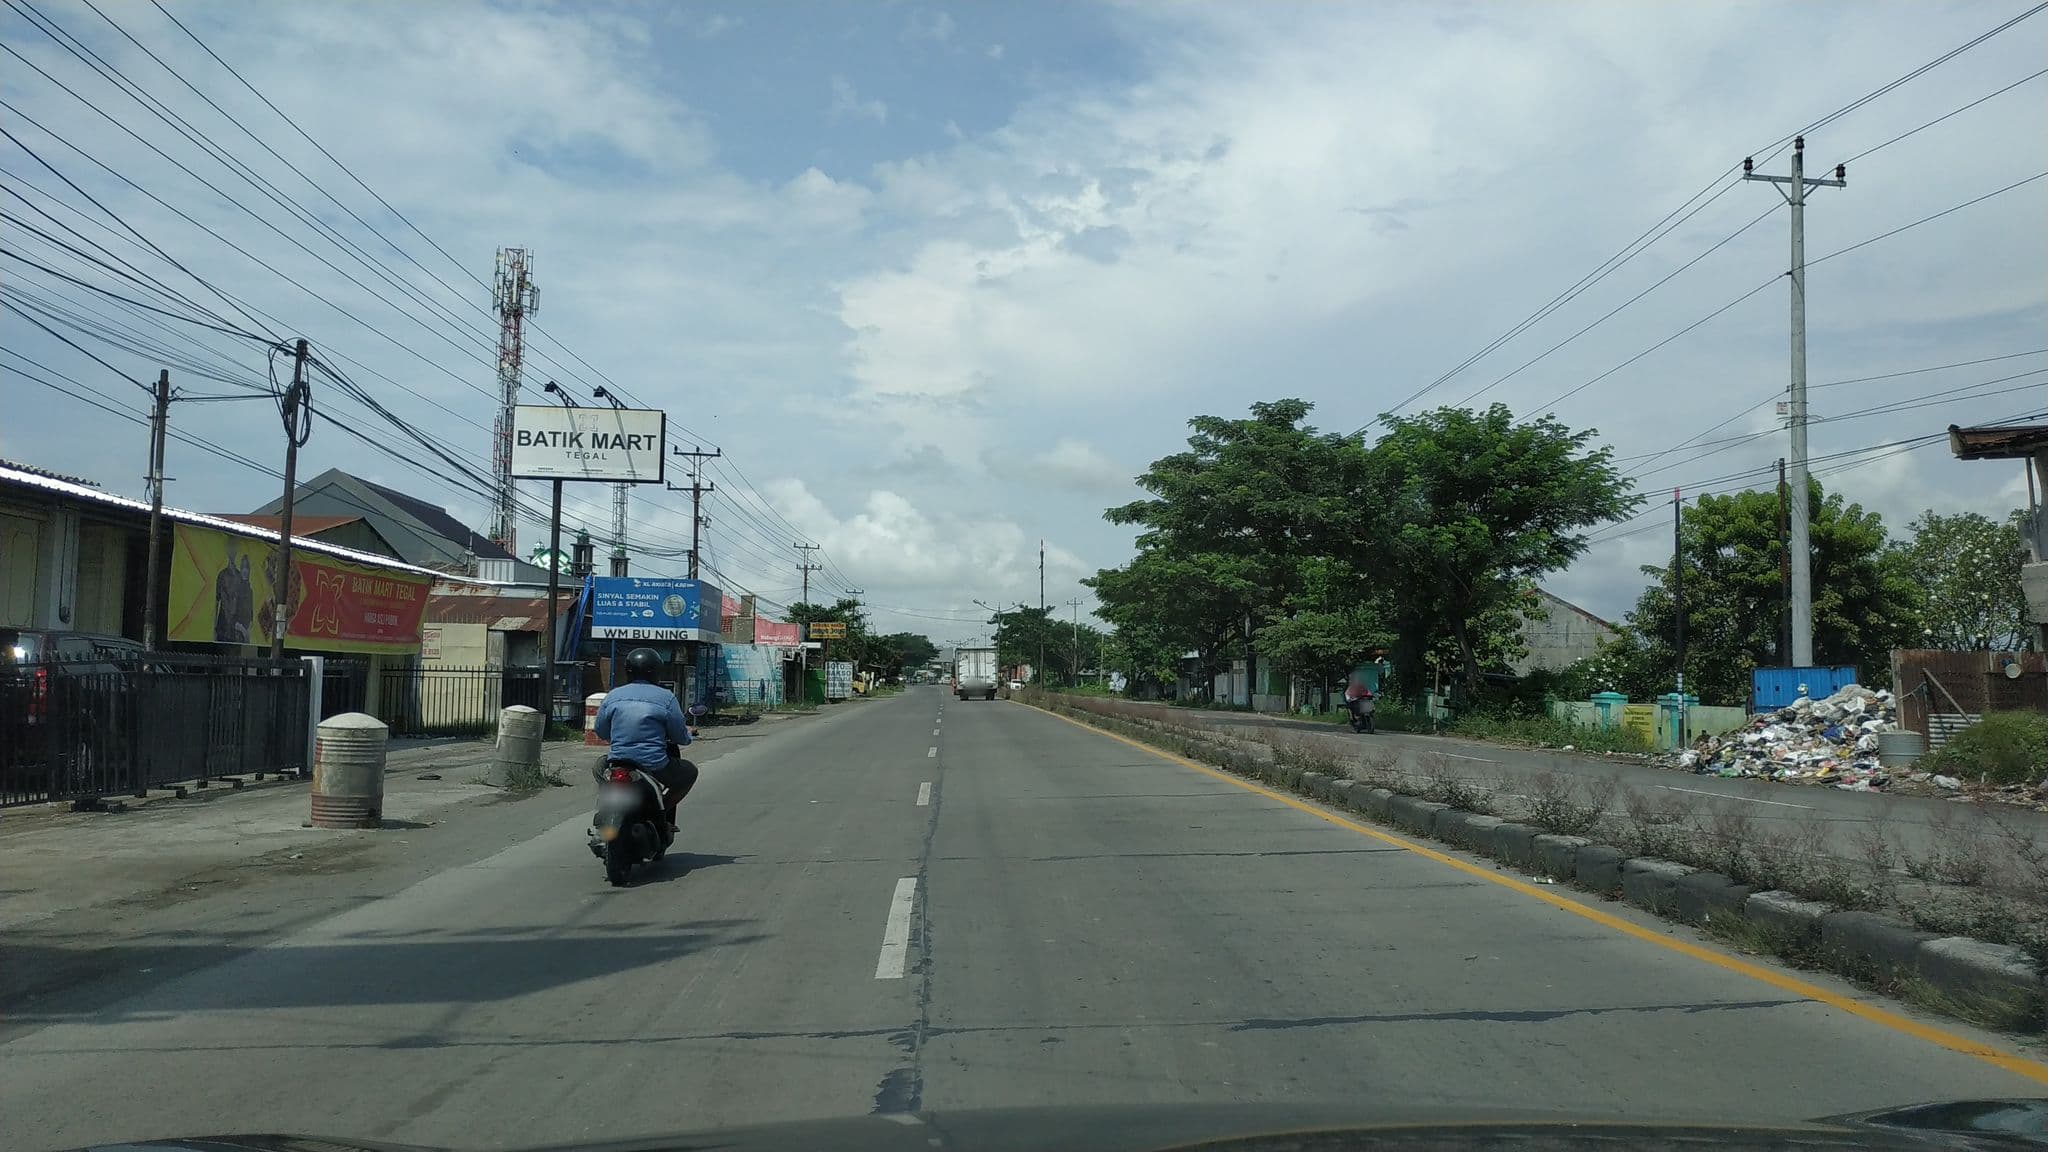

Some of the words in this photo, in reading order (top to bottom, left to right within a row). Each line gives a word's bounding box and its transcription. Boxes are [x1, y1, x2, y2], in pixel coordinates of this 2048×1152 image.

[517, 430, 584, 449] BATIK
[591, 432, 657, 451] MART
[566, 451, 608, 460] TEGAL
[351, 576, 373, 594] BATIK
[374, 580, 394, 599] MART
[395, 583, 416, 601] TEGAL
[597, 592, 624, 600] SINYAL
[603, 629, 628, 638] WM
[632, 629, 651, 639] BU
[655, 630, 688, 640] NING
